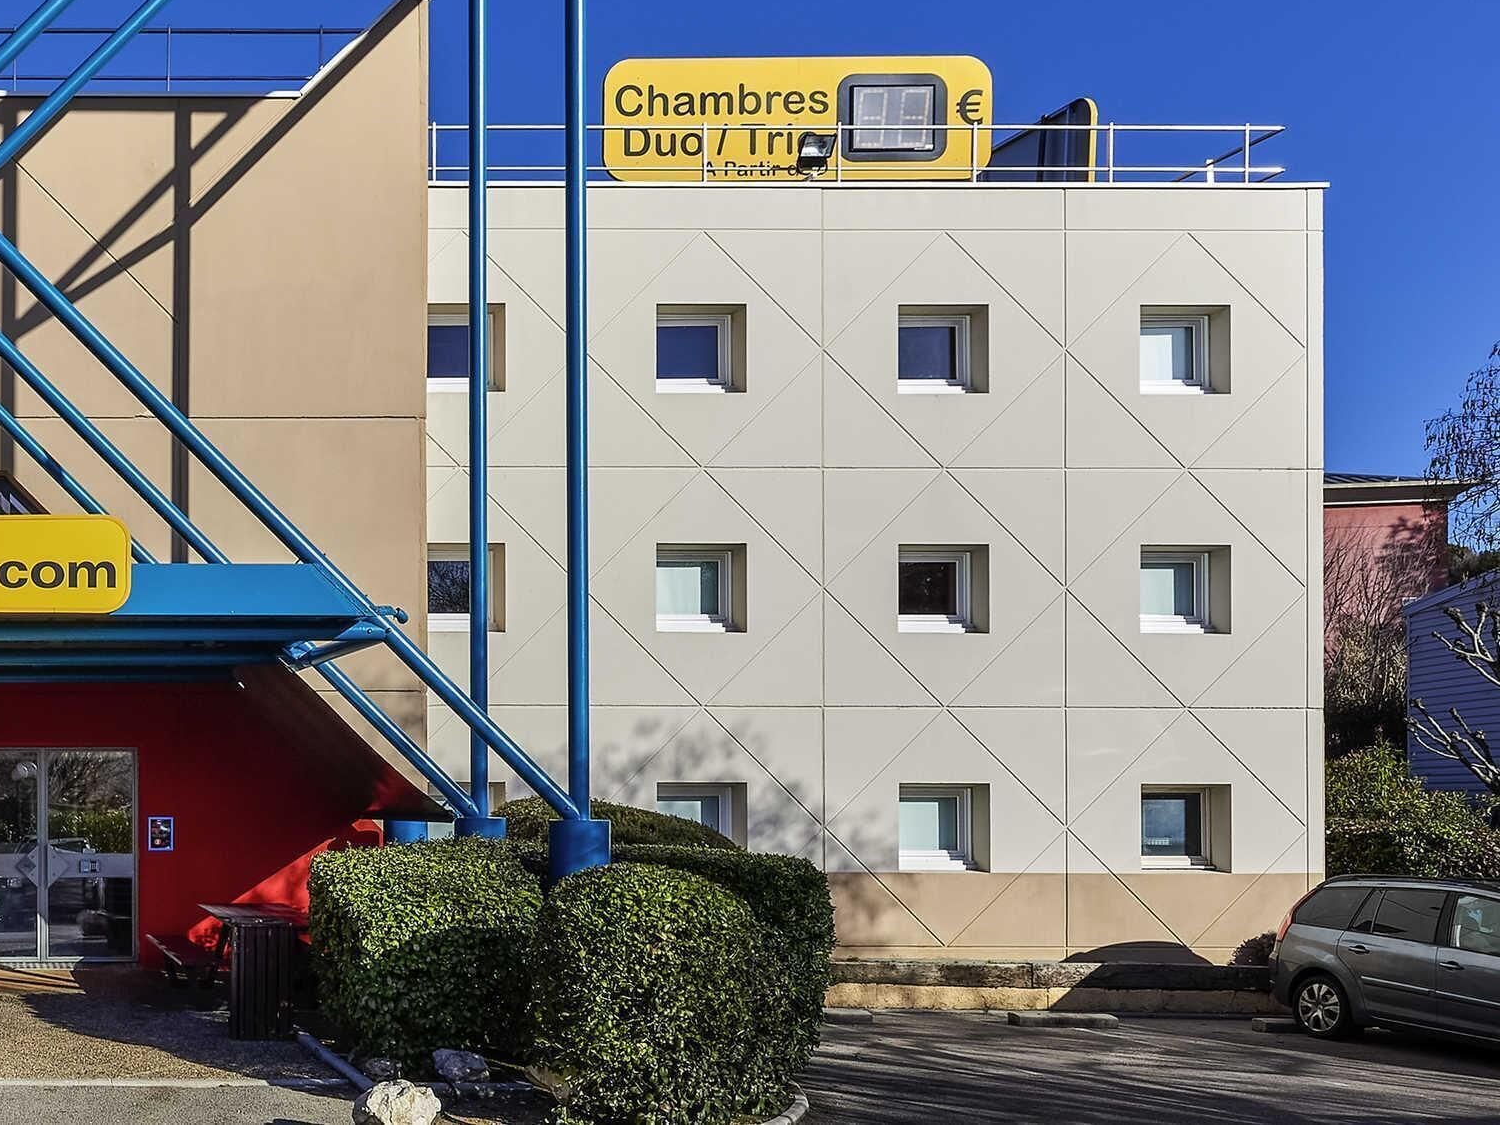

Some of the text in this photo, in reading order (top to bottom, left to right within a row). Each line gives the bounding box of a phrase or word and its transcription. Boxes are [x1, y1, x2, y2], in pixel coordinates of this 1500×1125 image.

[615, 83, 829, 117] Chambres
[623, 124, 704, 157] Duo
[740, 123, 820, 156] Tri
[724, 160, 781, 177] Partir
